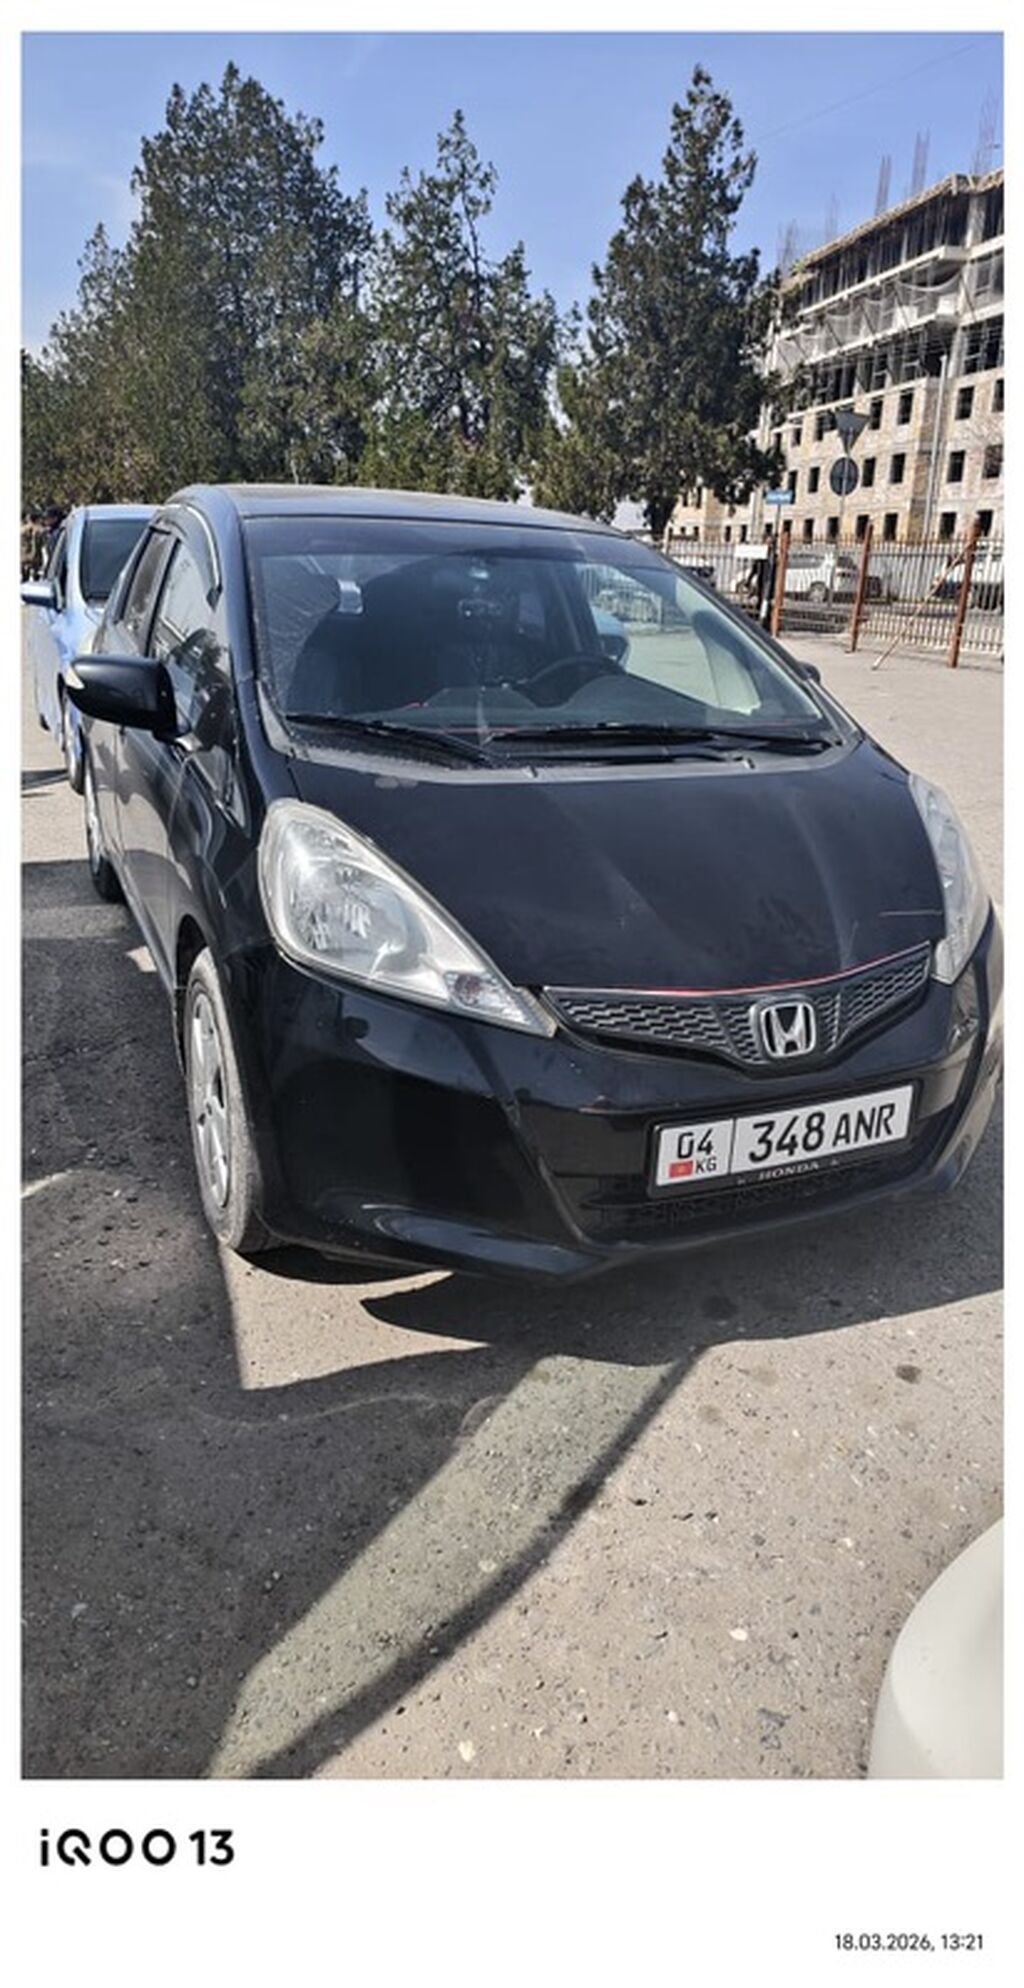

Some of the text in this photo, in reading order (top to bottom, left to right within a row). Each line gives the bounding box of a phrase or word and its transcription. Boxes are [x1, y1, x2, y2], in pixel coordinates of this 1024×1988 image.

[677, 1103, 896, 1163] 04 348 ANR
[695, 1156, 717, 1174] KG
[759, 1161, 819, 1180] HONDA
